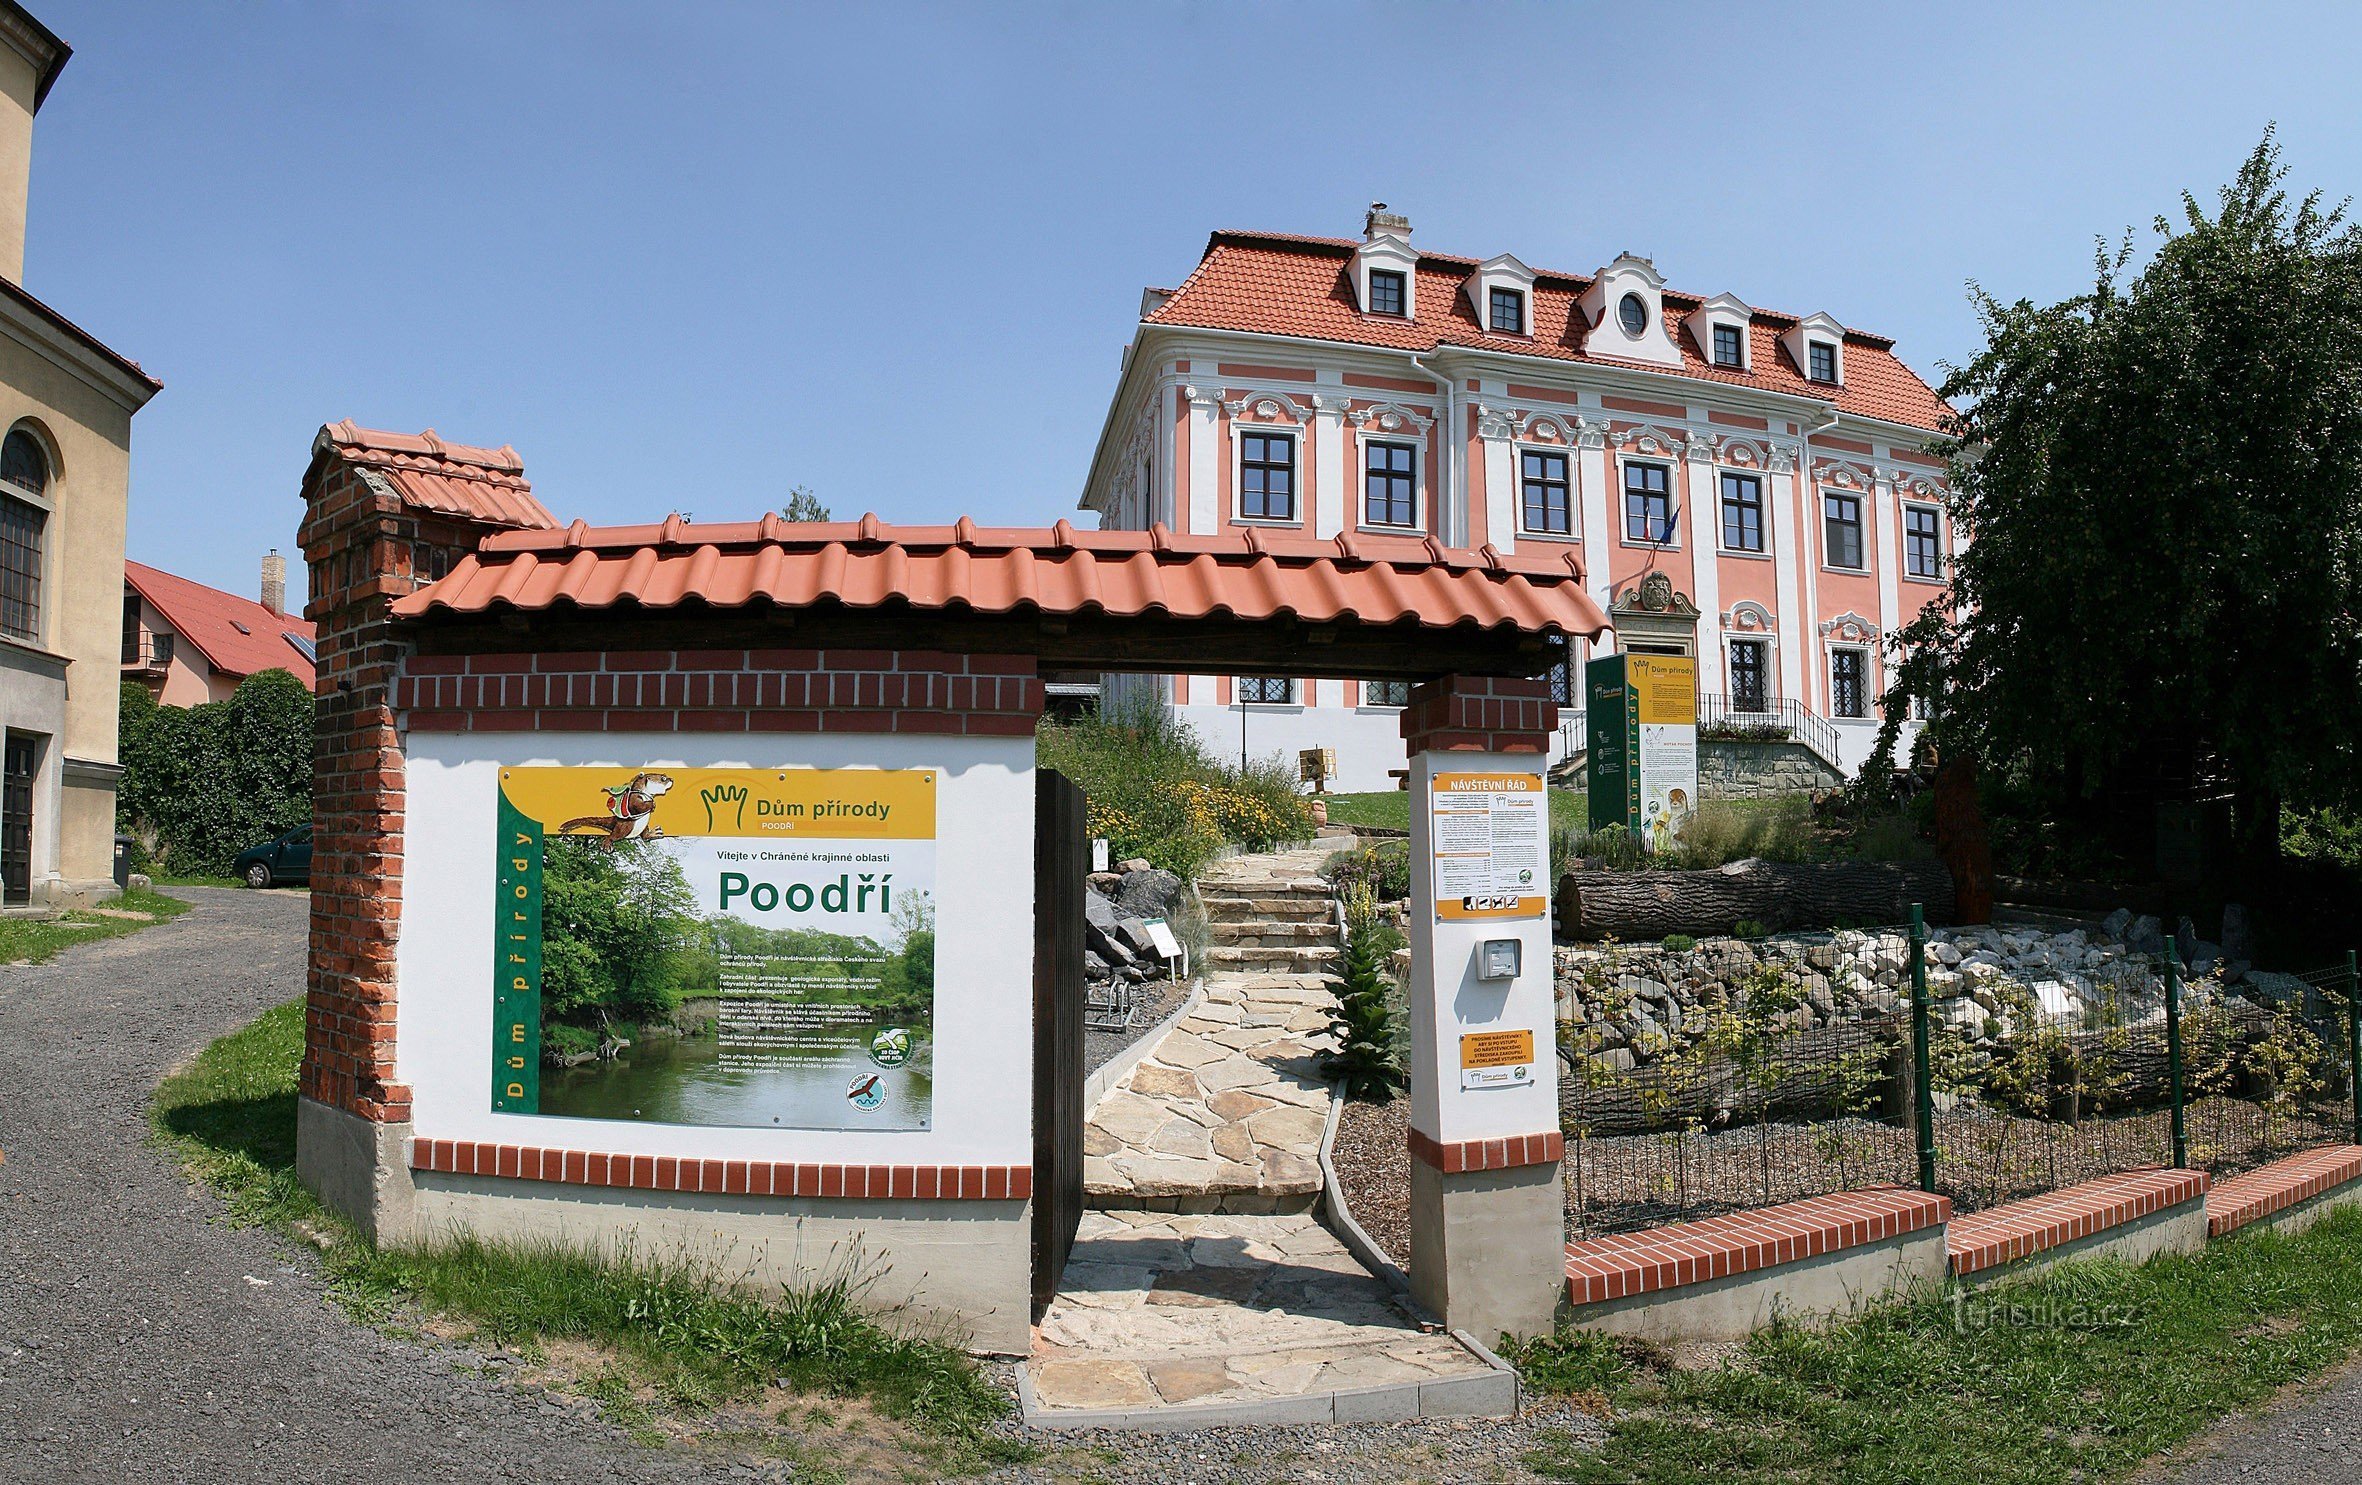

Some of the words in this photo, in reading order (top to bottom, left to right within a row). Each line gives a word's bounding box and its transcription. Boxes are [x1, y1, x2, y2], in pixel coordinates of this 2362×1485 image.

[1651, 665, 1667, 673] Dům
[1450, 779, 1505, 791] NÁVŠTĚVNÍ
[1507, 779, 1527, 791] ŘÁD
[757, 799, 804, 816] Dům
[813, 800, 890, 821] přírody
[761, 821, 794, 830] POODŘÍ
[717, 851, 748, 861] Vítejte
[760, 851, 808, 862] Chráněné
[811, 852, 852, 863] krajinné
[855, 853, 890, 862] oblasti
[719, 872, 893, 913] Poodří
[509, 832, 533, 990] přírody
[506, 1023, 525, 1098] Dům
